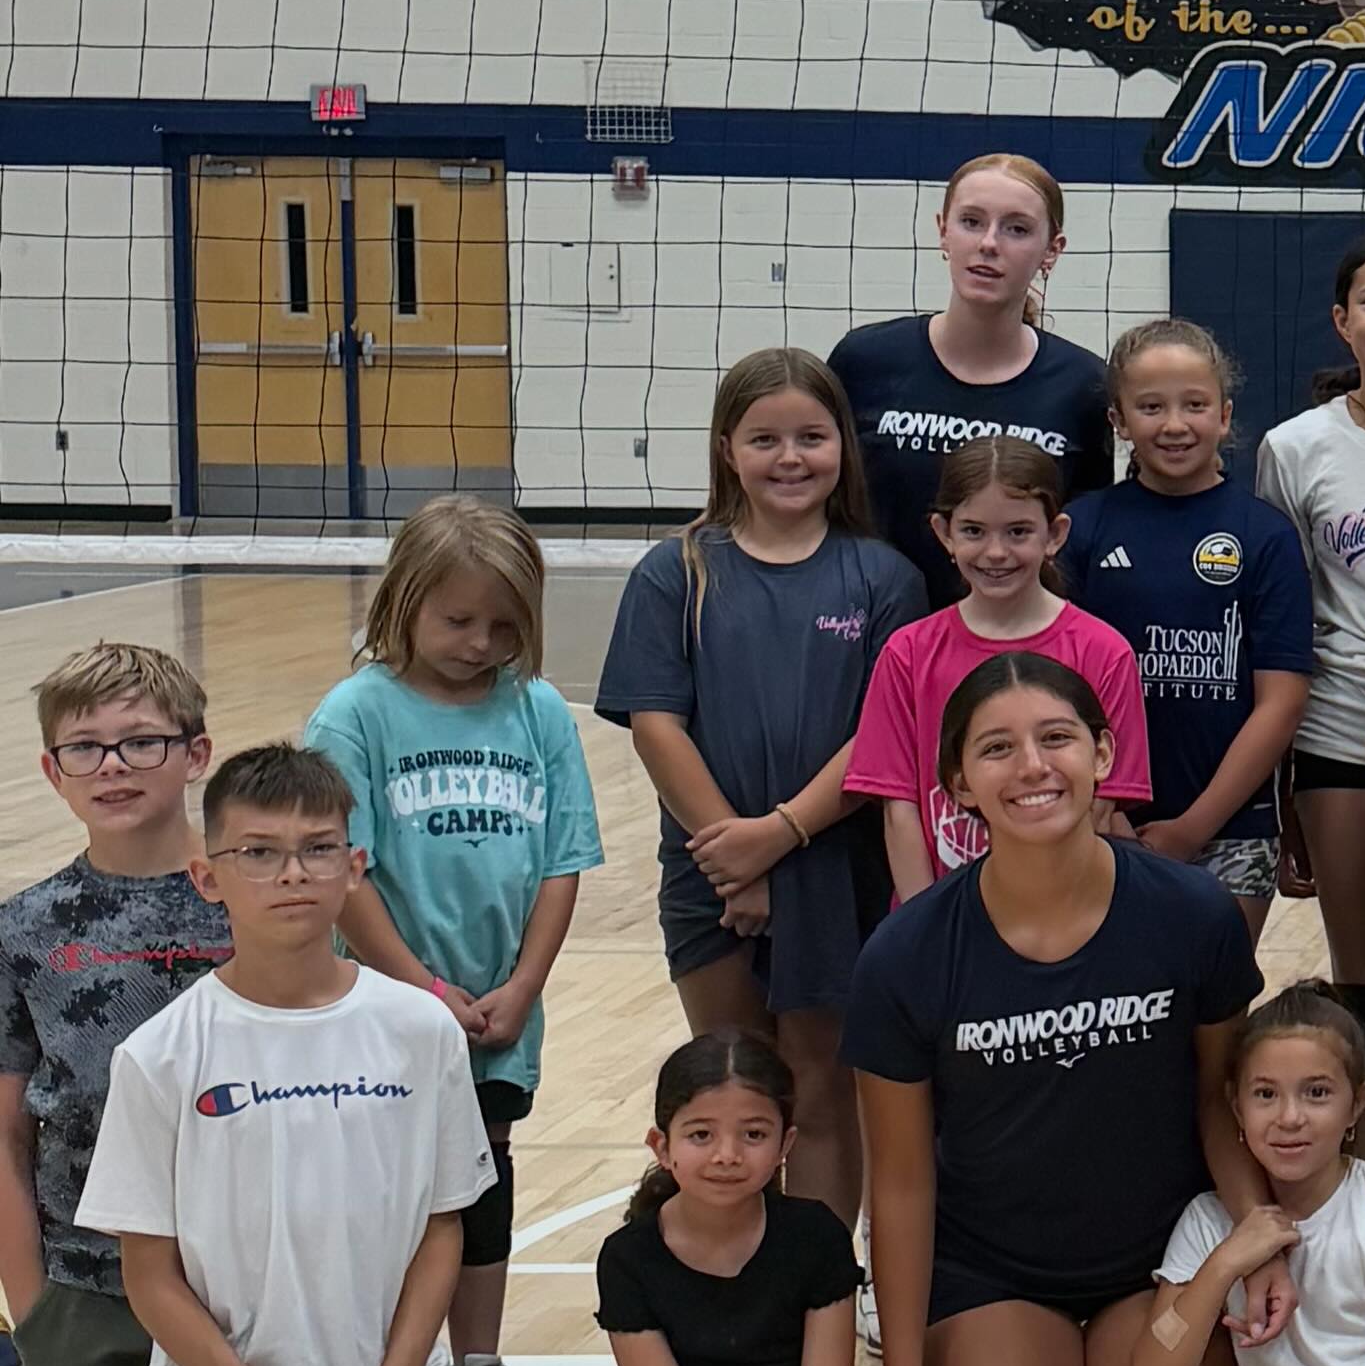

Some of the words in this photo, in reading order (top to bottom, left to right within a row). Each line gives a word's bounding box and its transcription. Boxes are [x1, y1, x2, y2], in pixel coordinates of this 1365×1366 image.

[1145, 625, 1223, 654] TUCSON
[1138, 653, 1226, 680] OPAEDIC
[1143, 682, 1236, 701] TITUTE
[398, 750, 486, 774] IRONWOOD
[489, 750, 533, 777] RIDGE
[385, 768, 546, 824] VOLLEYBALL
[427, 809, 513, 836] CAMPS
[956, 1001, 1097, 1051] IRONWOOD
[1097, 988, 1175, 1029] RIDGE
[983, 1025, 1152, 1066] VOLLEYBALL
[196, 1075, 413, 1117] Champion
